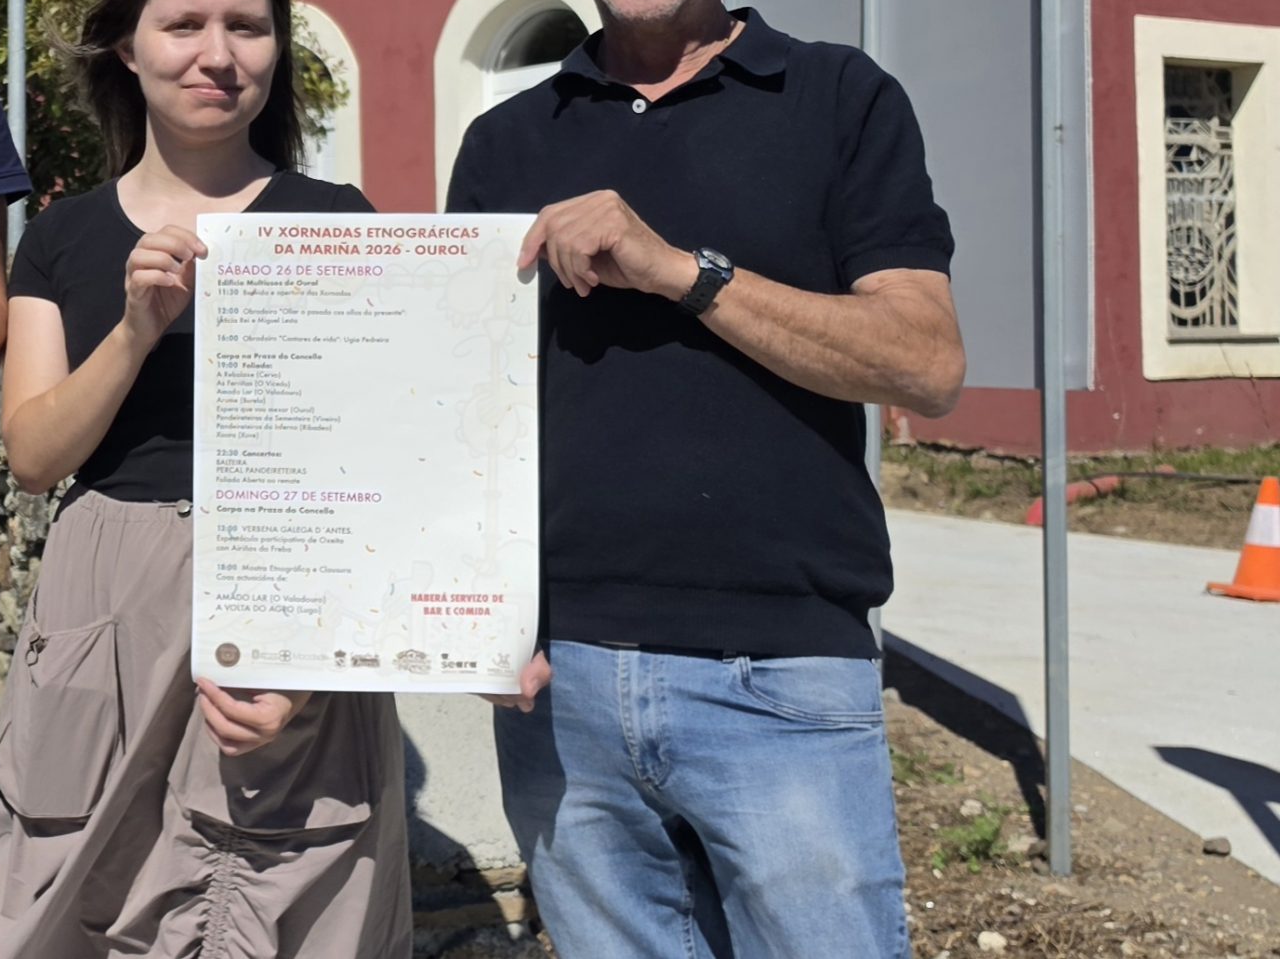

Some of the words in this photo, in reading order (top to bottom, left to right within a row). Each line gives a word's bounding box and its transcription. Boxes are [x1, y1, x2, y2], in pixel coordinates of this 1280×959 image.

[258, 226, 273, 238] IV
[279, 226, 362, 238] XORNADAS
[366, 224, 480, 239] ETNOGRÁFICAS
[275, 244, 295, 255] DA
[300, 242, 360, 256] MARIÑA
[365, 244, 402, 256] 2026
[414, 244, 467, 256] OUROL
[218, 263, 271, 276] SÁBADO
[276, 265, 292, 275] 26
[296, 266, 312, 276] DE
[317, 266, 383, 277] SETEMBRO
[216, 490, 280, 501] DOMINGO
[284, 491, 297, 501] 27
[302, 492, 317, 501] DE
[320, 492, 382, 502] SETEMBRO
[410, 591, 447, 603] HABERÁ
[450, 594, 488, 603] SERVIZO
[493, 594, 504, 603] DE
[423, 607, 442, 616] BAR
[445, 607, 450, 616] E
[453, 607, 491, 616] COMIDA
